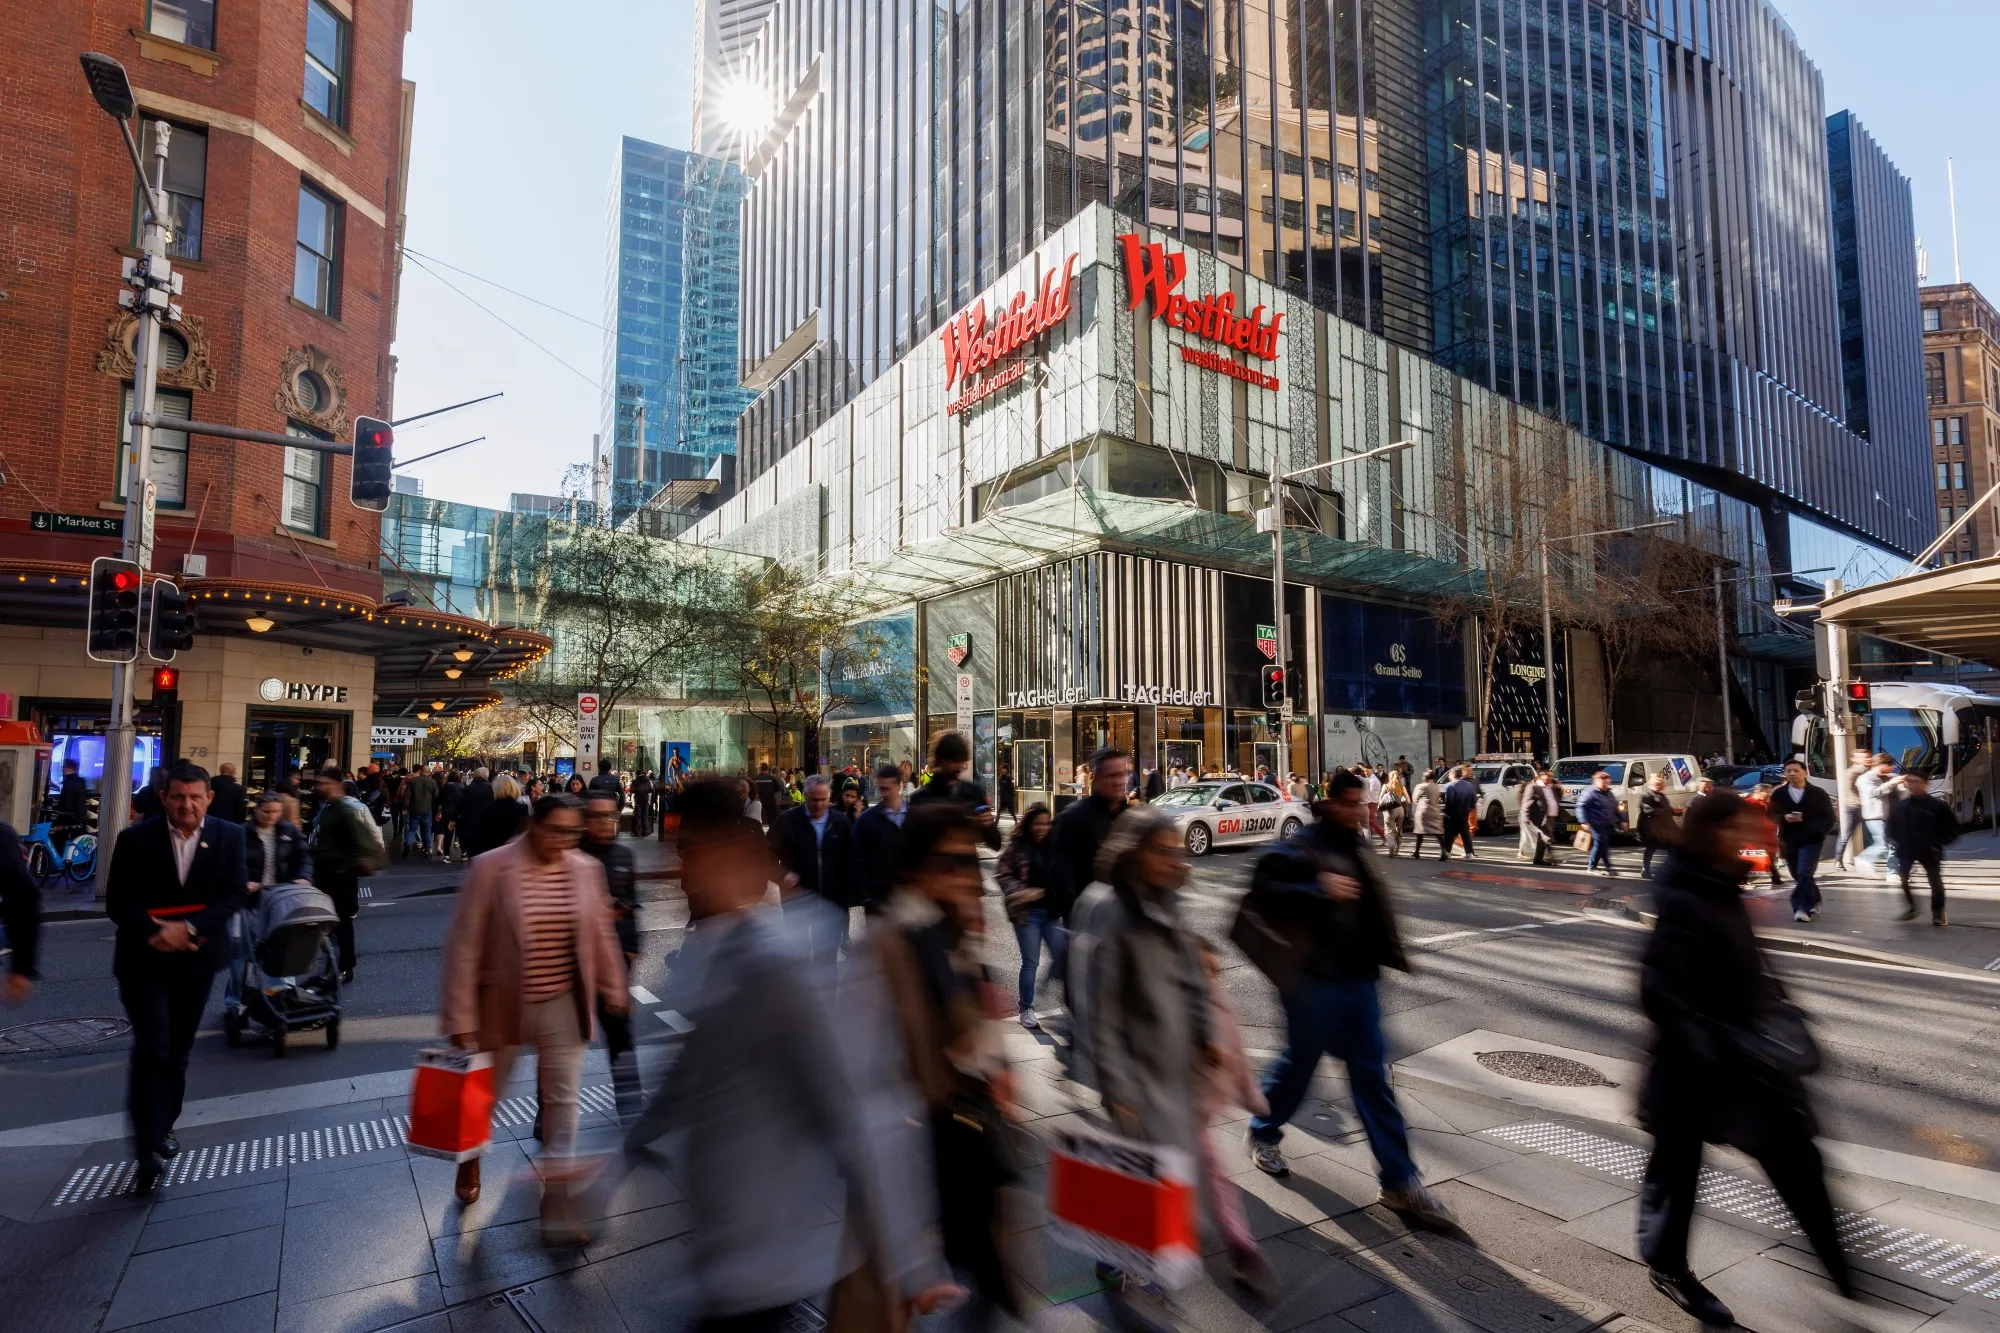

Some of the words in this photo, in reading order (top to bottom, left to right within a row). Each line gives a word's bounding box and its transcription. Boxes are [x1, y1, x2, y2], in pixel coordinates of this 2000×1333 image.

[1116, 233, 1285, 361] Westfield
[939, 251, 1079, 391] Westfield
[1180, 346, 1279, 391] westfield.com.au
[946, 360, 1026, 417] westfield.com.au
[58, 515, 101, 529] Market
[103, 519, 117, 530] St
[1374, 662, 1400, 677] Grand
[1402, 665, 1423, 679] Seiko
[1509, 663, 1546, 679] LONGINE
[284, 681, 348, 703] HYPE
[374, 727, 418, 736] MYER
[188, 746, 209, 758] 78
[1217, 818, 1241, 834] GM
[1245, 817, 1259, 832] 131
[1259, 816, 1277, 831] 001
